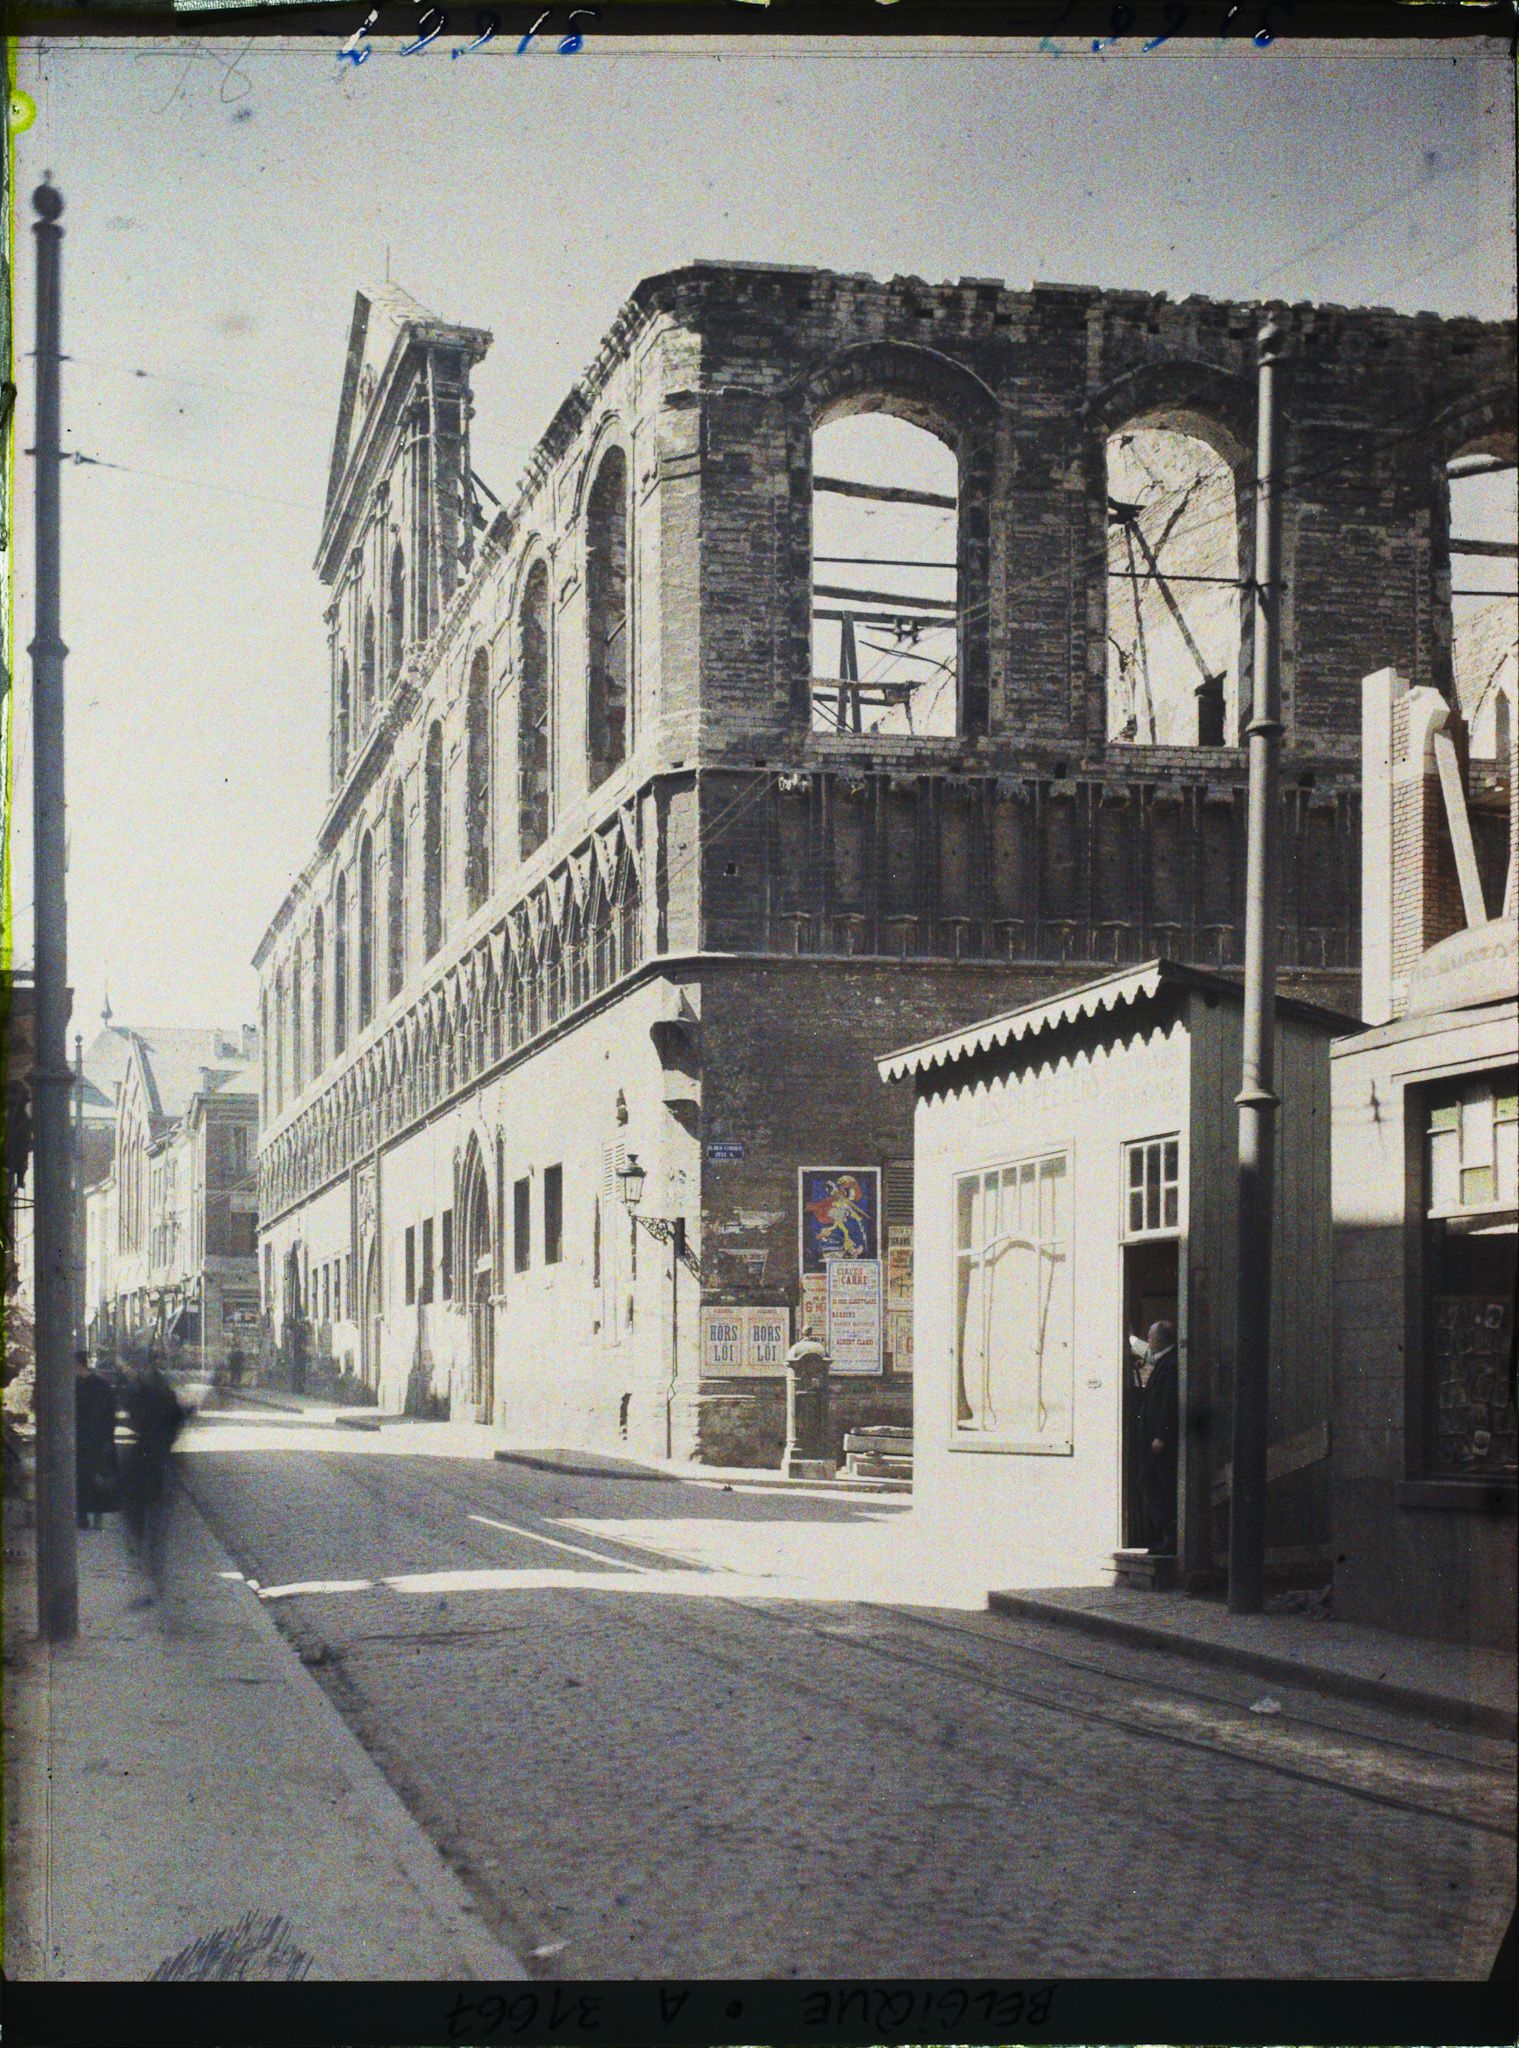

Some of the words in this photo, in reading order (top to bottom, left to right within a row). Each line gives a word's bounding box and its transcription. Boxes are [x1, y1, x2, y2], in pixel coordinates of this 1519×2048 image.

[710, 1325, 738, 1341] HORS
[753, 1325, 781, 1342] HORS
[714, 1345, 733, 1361] LOI
[757, 1345, 776, 1362] LOI
